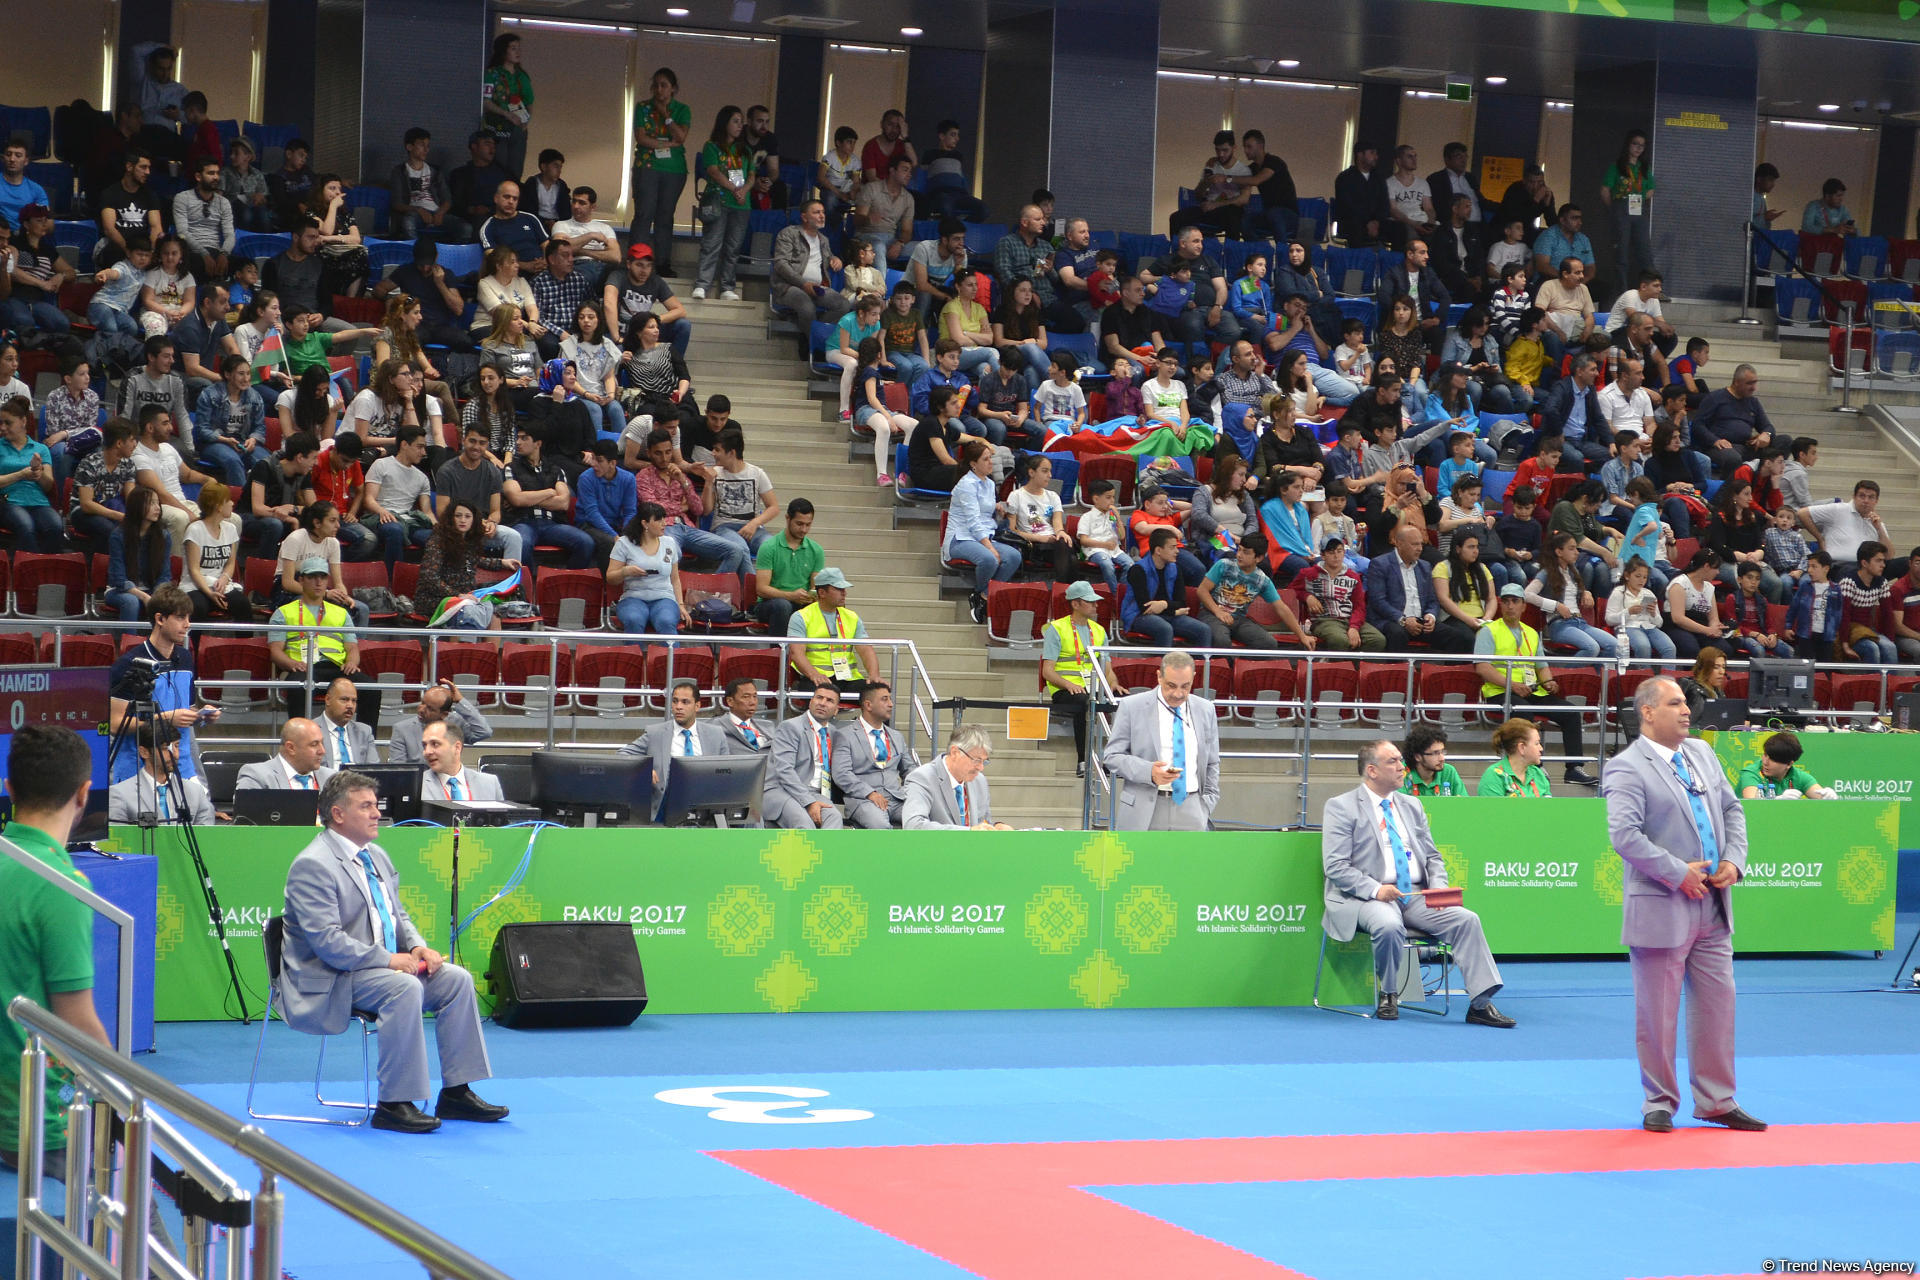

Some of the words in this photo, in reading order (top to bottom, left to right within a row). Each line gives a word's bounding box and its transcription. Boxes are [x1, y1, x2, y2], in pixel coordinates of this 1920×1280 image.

[137, 391, 171, 402] KENZO
[204, 546, 222, 558] LOVE
[10, 700, 25, 731] 0
[41, 713, 47, 721] C
[55, 712, 61, 720] K
[66, 712, 76, 720] HC
[82, 711, 88, 719] H
[97, 722, 109, 736] C2
[1834, 780, 1872, 793] BAKU
[1876, 780, 1912, 793] 2017
[1485, 862, 1530, 877] BAKU
[1534, 862, 1579, 877] 2017
[1743, 863, 1776, 878] AKU
[1781, 862, 1823, 877] 2017
[1484, 880, 1496, 888] 4th
[1497, 879, 1520, 888] Islamic
[1521, 879, 1554, 889] Solidarity
[1555, 880, 1578, 888] Games
[1744, 880, 1767, 888] Islamic
[1767, 880, 1799, 889] Solidarity
[1800, 880, 1823, 888] Games
[563, 906, 622, 922] BAKU
[629, 905, 687, 924] 2017
[889, 905, 944, 922] BAKU
[951, 905, 1006, 923] 2017
[1197, 905, 1249, 922] BAKU
[1256, 904, 1307, 922] 2017
[208, 928, 224, 937] 4t
[225, 928, 259, 937] Islamic
[656, 926, 686, 935] Games
[888, 925, 901, 934] 4th
[904, 925, 932, 935] Islamic
[934, 925, 975, 936] Solidarity
[977, 925, 1005, 935] Games
[1197, 925, 1210, 933] 4th
[1211, 924, 1239, 933] Islamic
[1240, 924, 1279, 935] Solidarity
[1280, 925, 1306, 933] Games
[654, 1085, 875, 1124] 3
